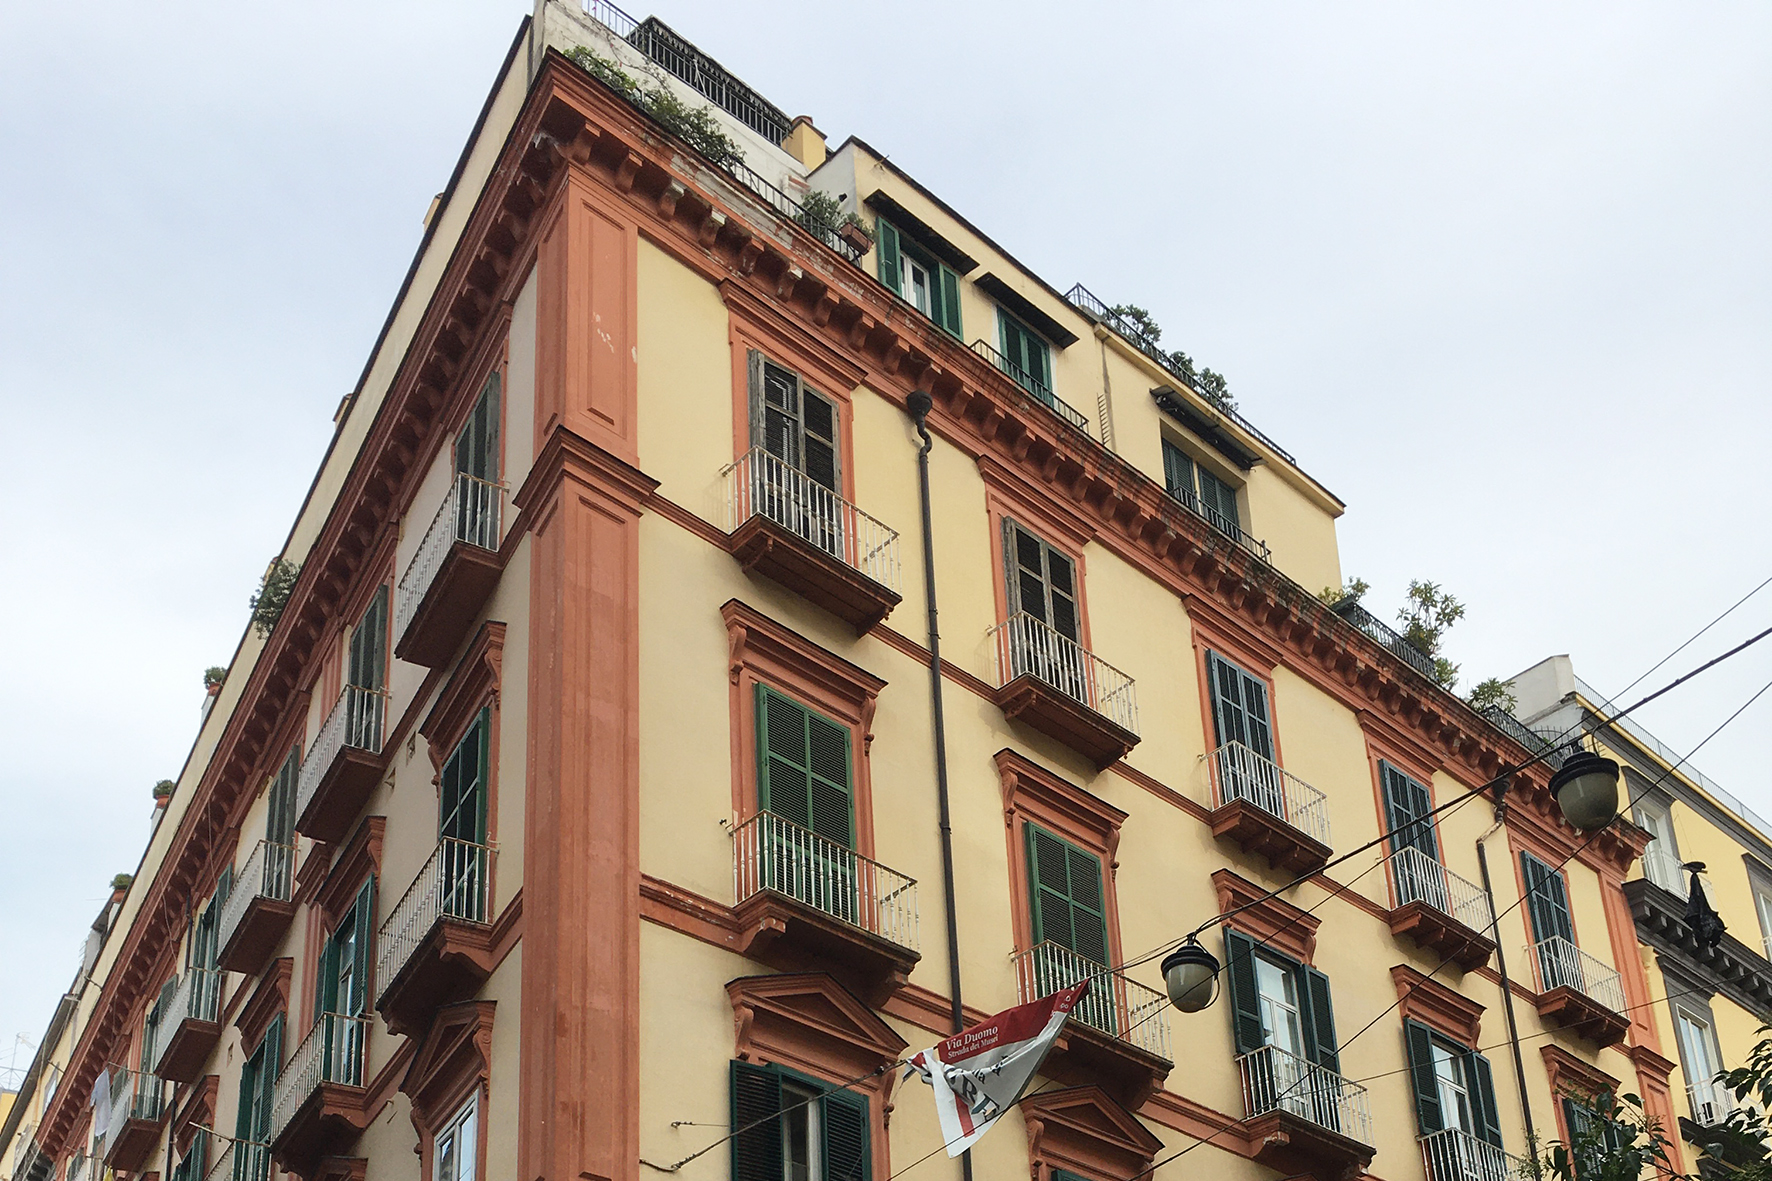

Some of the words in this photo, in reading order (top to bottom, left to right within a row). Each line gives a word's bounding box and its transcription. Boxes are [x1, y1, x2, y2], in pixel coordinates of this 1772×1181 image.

[946, 1038, 962, 1050] Via
[964, 1026, 998, 1045] Duomo
[948, 1045, 970, 1059] Strada
[970, 1041, 980, 1051] dei
[981, 1034, 999, 1047] Musei
